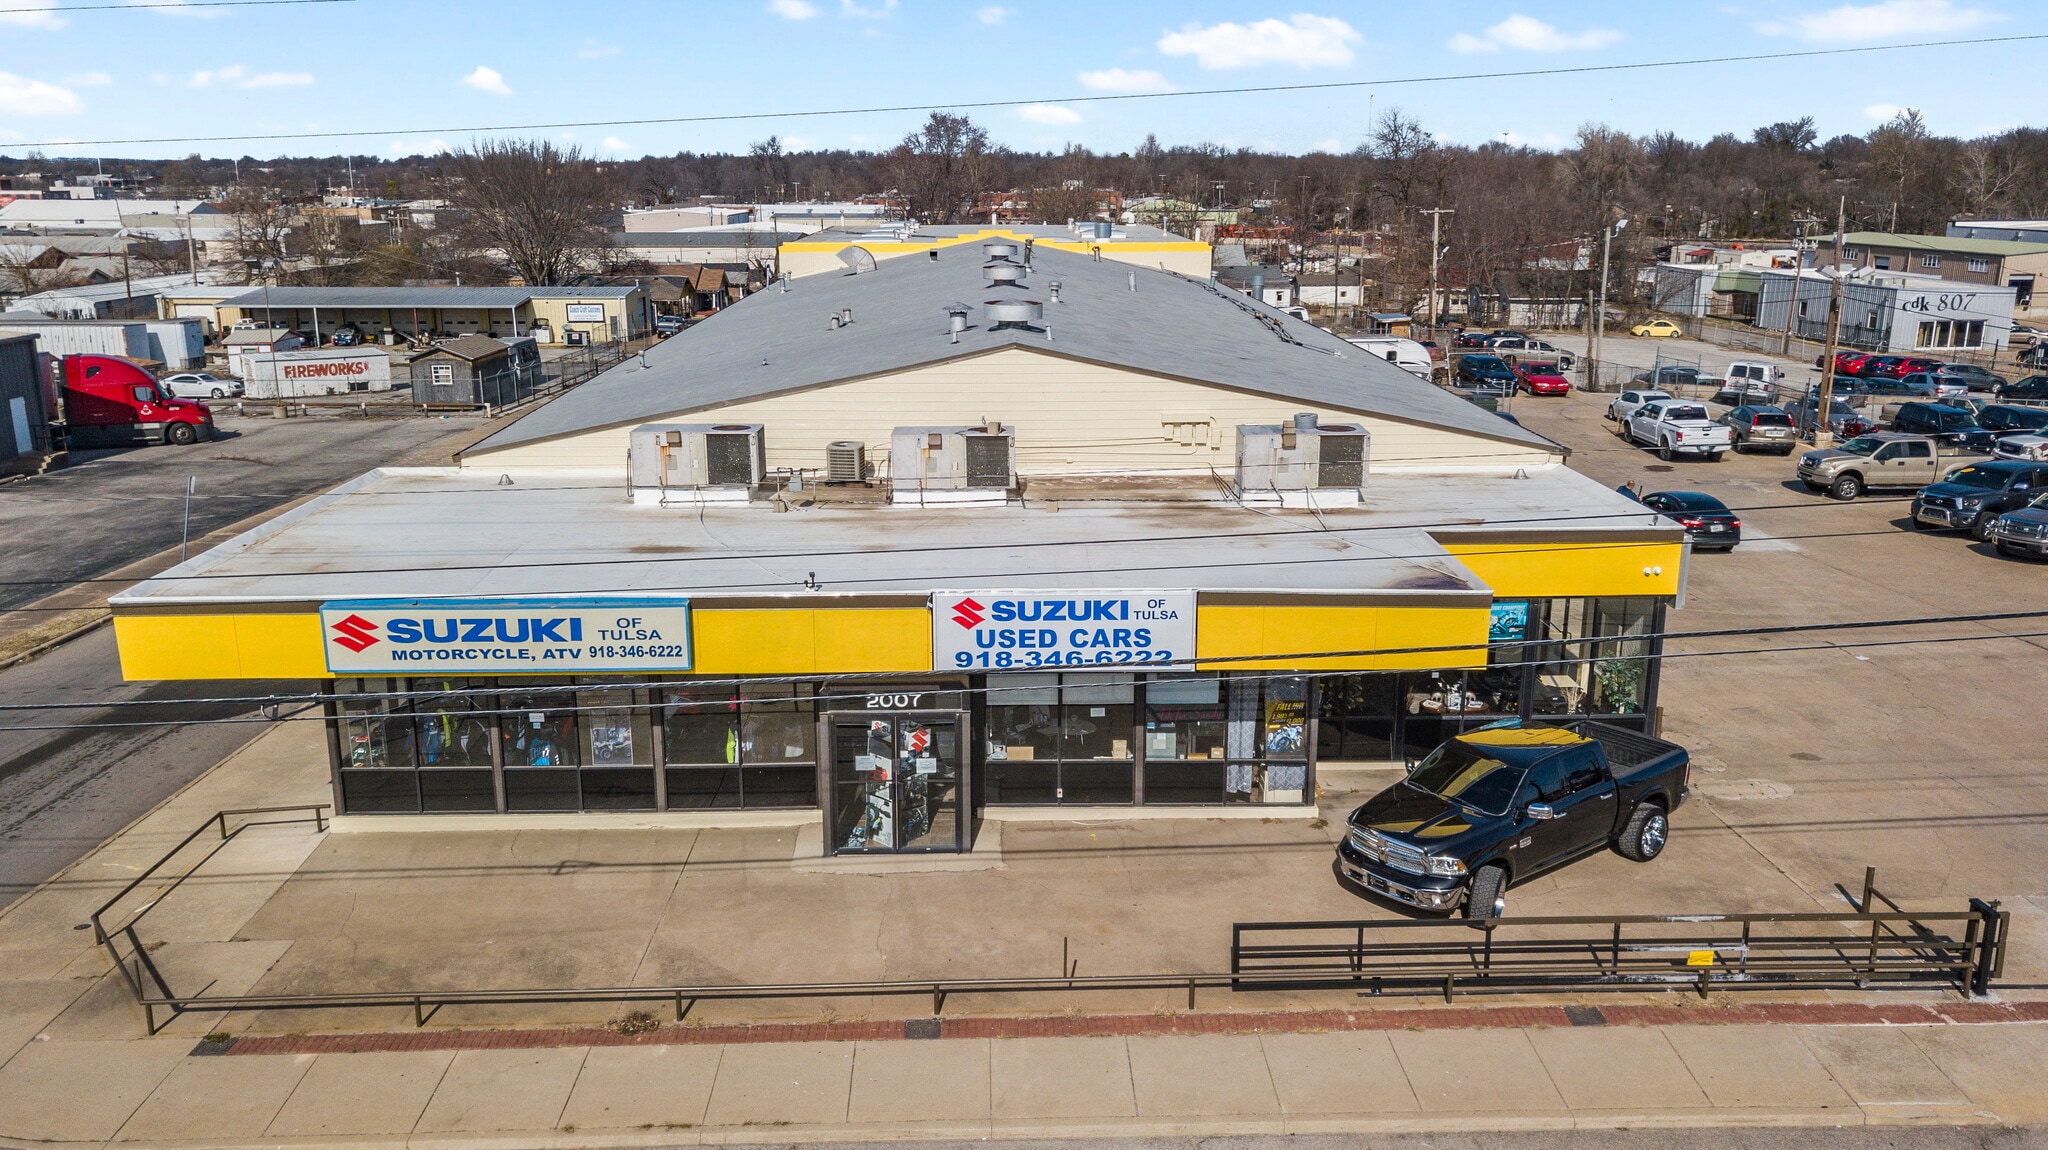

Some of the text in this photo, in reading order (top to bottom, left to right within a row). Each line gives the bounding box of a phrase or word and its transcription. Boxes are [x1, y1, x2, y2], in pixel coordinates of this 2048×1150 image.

[1902, 293, 1977, 312] cdk 807
[991, 599, 1129, 622] SUZUKI
[1147, 599, 1166, 609] OF
[616, 617, 642, 629] OF
[1133, 610, 1179, 620] TULSA
[386, 617, 583, 644] SUZUKI
[597, 629, 662, 641] TULSA
[976, 628, 1152, 649] USED CARS
[391, 645, 683, 661] MOTORCYCLE, ATV 918-346-6222
[954, 650, 1172, 668] 918-346-6222
[867, 693, 922, 708] 2007
